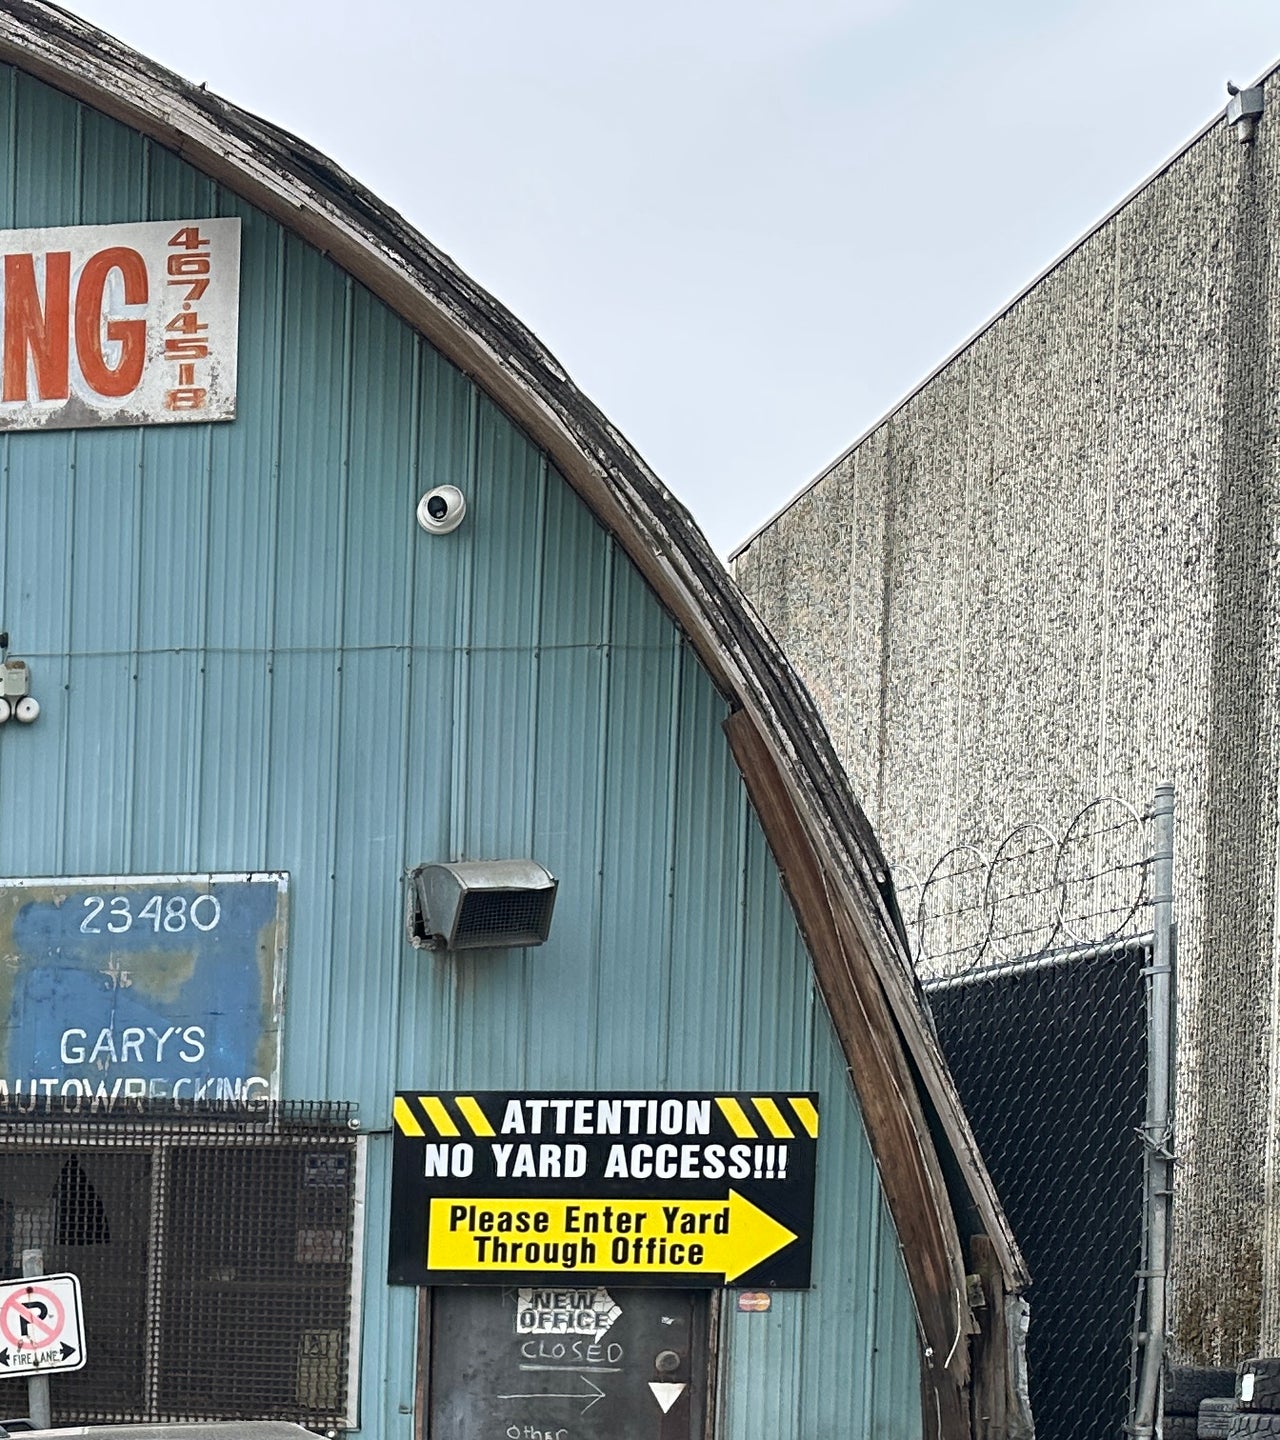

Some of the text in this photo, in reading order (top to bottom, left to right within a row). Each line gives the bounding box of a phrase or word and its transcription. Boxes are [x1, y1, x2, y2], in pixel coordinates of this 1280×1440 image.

[79, 894, 221, 934] 23480
[60, 1026, 205, 1064] GARY'S
[501, 1099, 711, 1136] ATTENTION
[424, 1142, 788, 1179] NO YARD ACCESS!!!
[450, 1204, 730, 1235] Please Enter Yard
[474, 1236, 704, 1268] Through Office
[534, 1290, 593, 1310] NEW
[520, 1309, 610, 1329] OFFICE
[12, 1353, 32, 1366] FIRE
[521, 1340, 623, 1363] CLOSED
